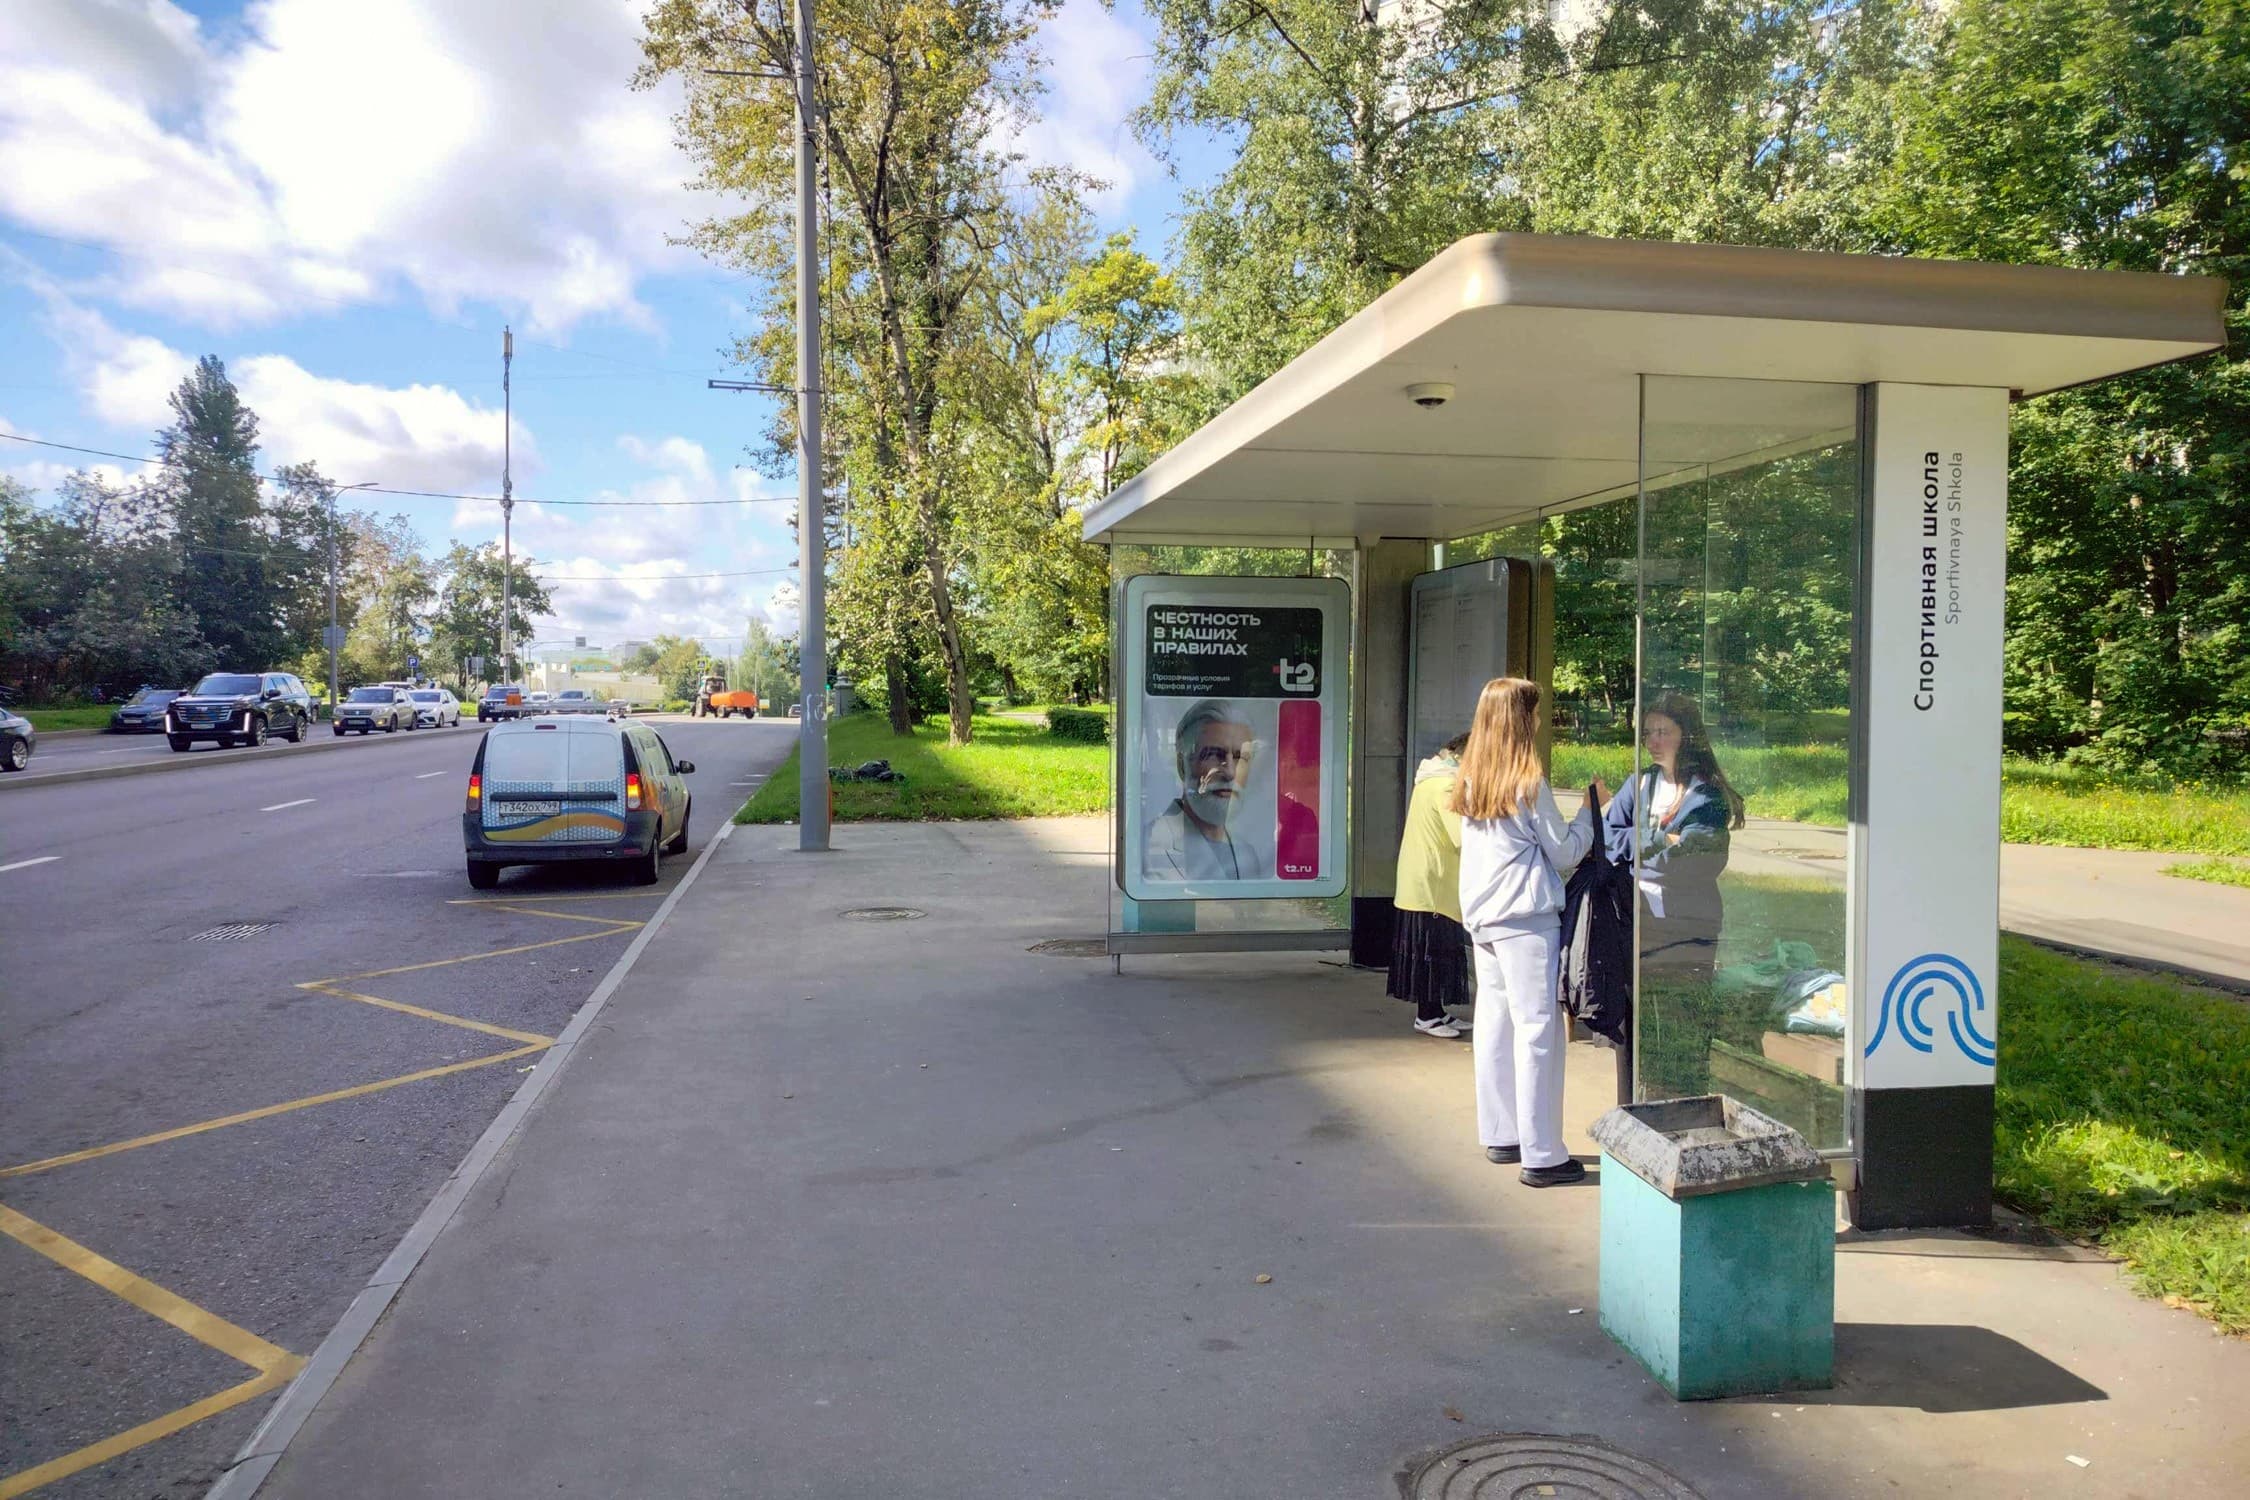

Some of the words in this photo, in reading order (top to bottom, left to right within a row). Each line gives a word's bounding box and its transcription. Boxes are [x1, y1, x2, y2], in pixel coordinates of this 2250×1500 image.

[1947, 452, 1963, 511] Shkola
[1923, 451, 1939, 537] школа
[1945, 516, 1964, 625] Sportivnaya
[1153, 611, 1262, 626] ЧЕСТНОСТЬ
[1153, 627, 1166, 639] В
[1171, 627, 1238, 641] НАШИХ
[1914, 546, 1939, 711] Спортивная
[1153, 641, 1249, 656] ПРАВИЛАХ
[1152, 673, 1199, 682] Прозрачные
[1200, 675, 1231, 683] условия
[1152, 683, 1185, 691] тарифов
[1193, 684, 1213, 692] услуг
[1283, 864, 1312, 873] t2.ru
